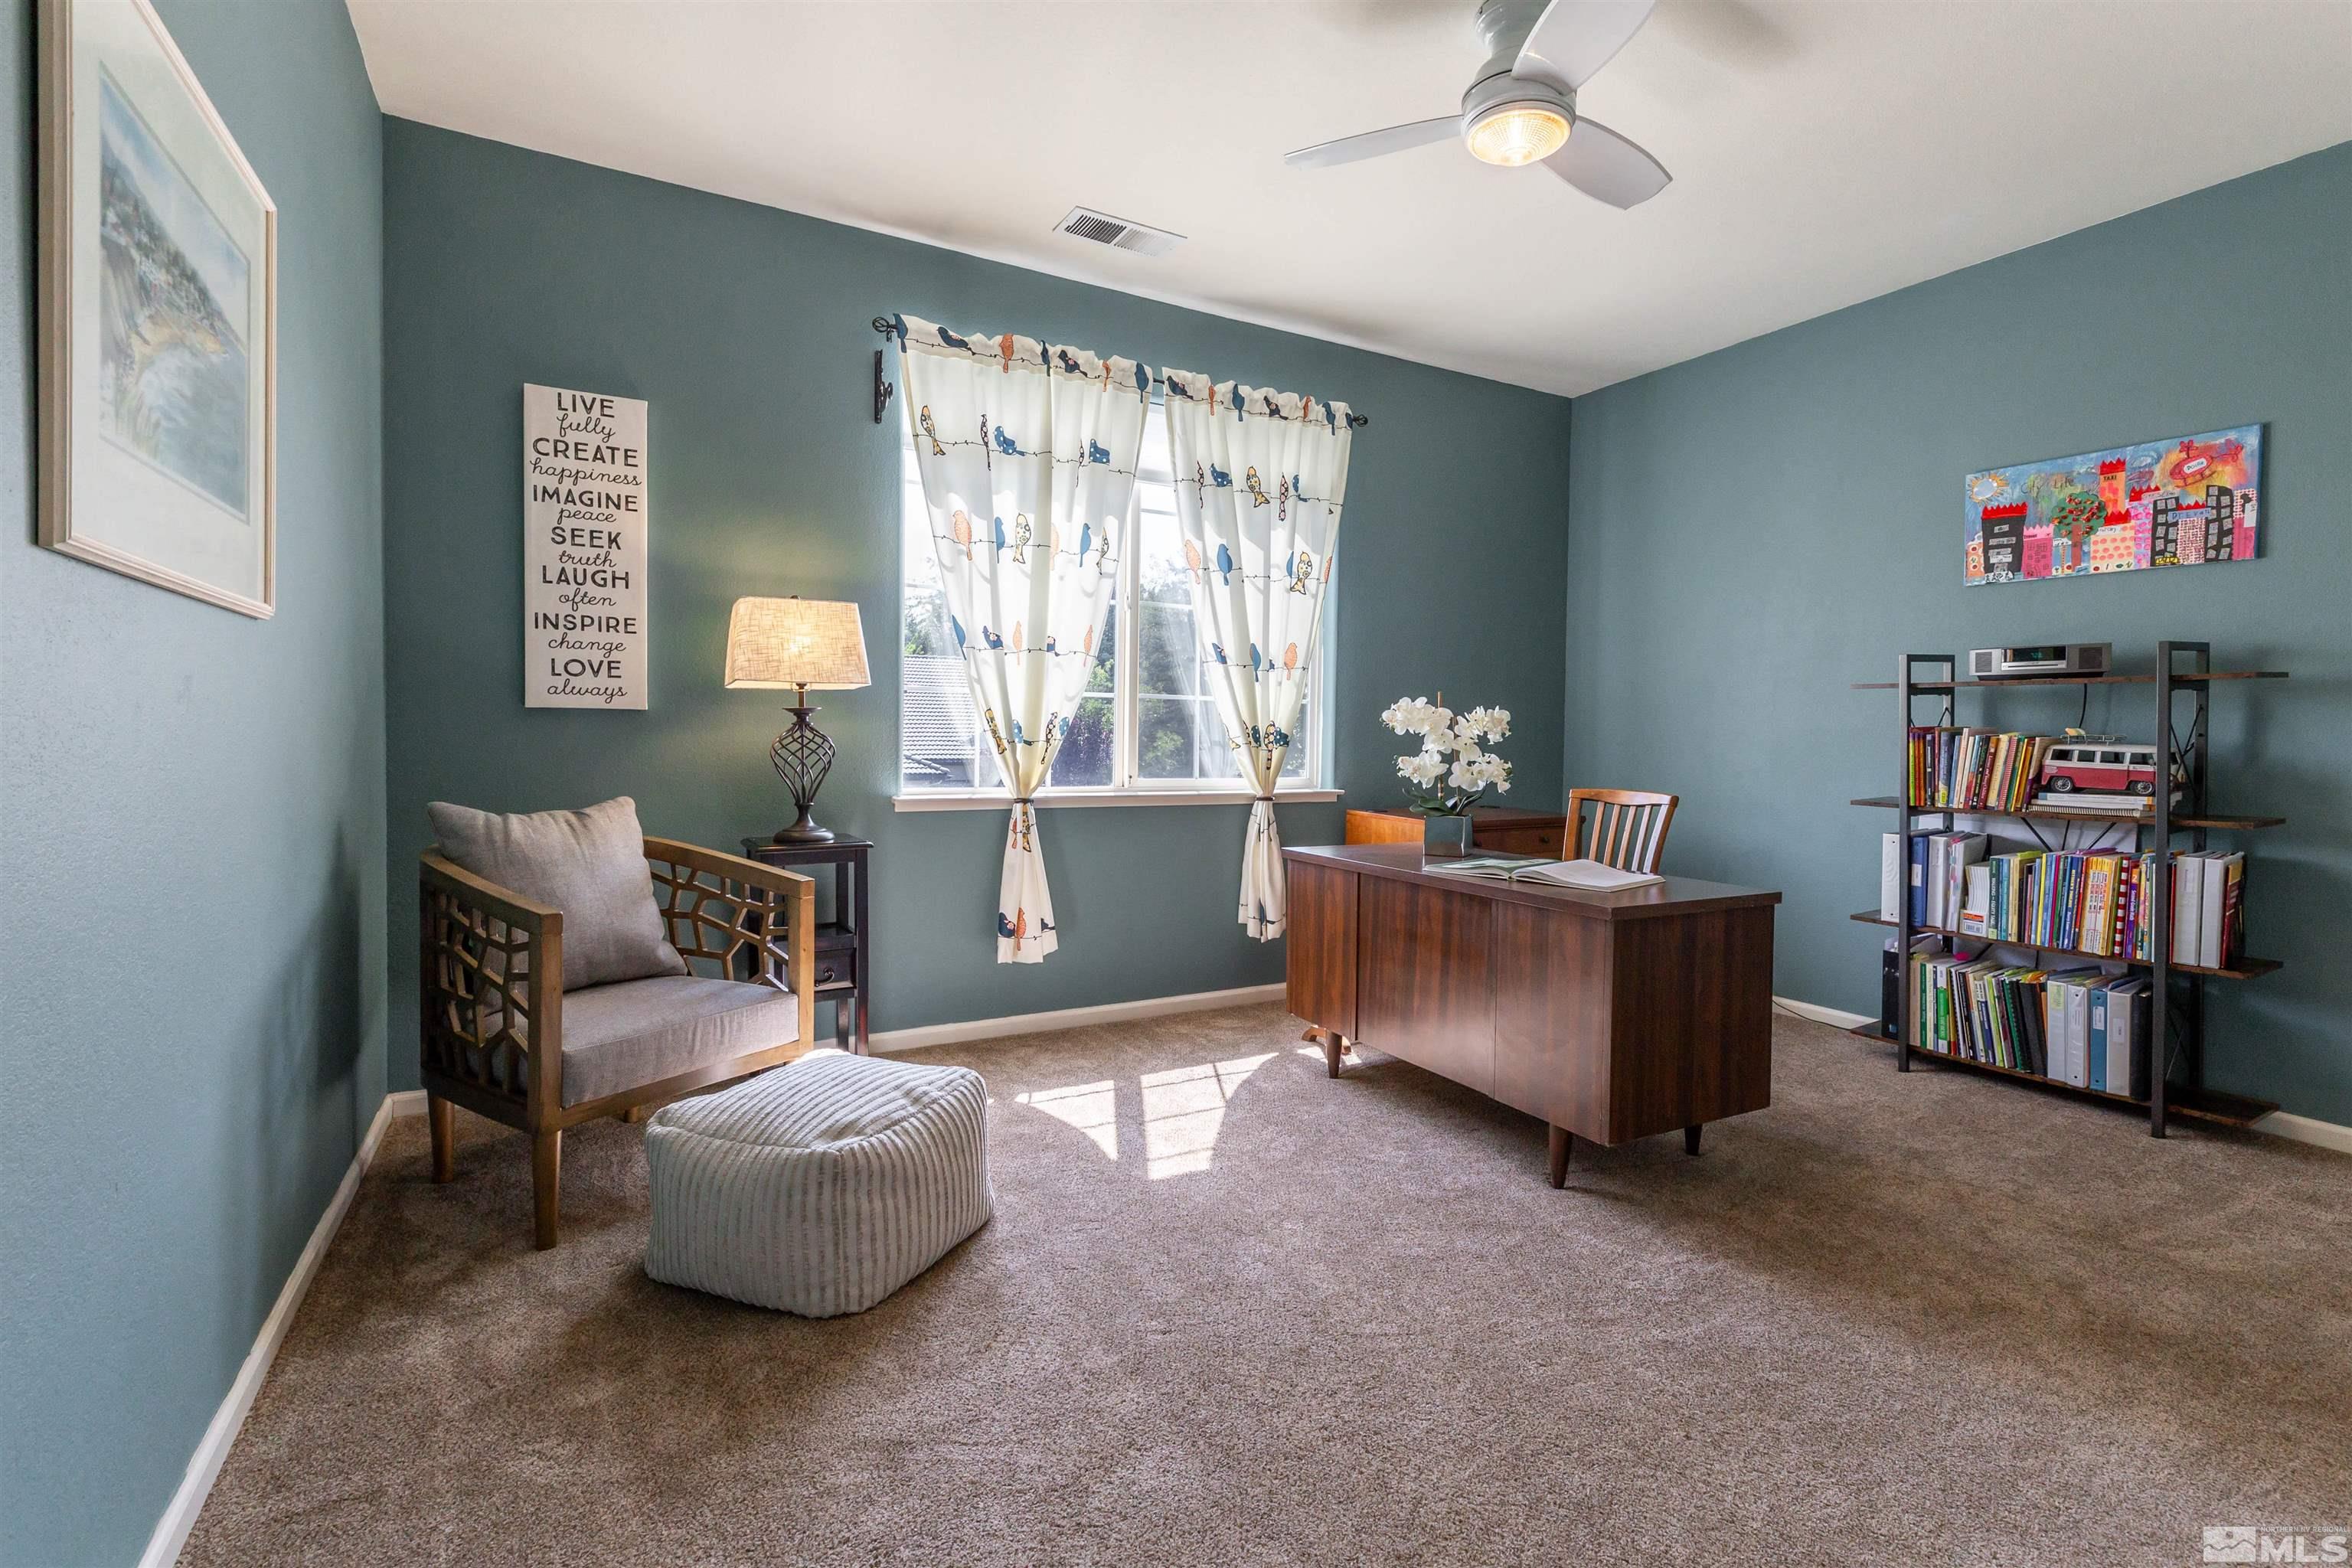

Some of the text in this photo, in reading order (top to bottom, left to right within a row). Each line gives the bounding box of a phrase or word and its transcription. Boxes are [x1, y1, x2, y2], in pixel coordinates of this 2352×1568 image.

[557, 392, 615, 418] LIVE
[557, 413, 616, 443] fully
[532, 437, 639, 467] CREATE
[530, 457, 642, 485] happiness
[533, 485, 638, 512] IMAGINE
[557, 508, 616, 524] peace
[550, 526, 622, 550] SEEK
[559, 550, 617, 567] truth
[542, 565, 629, 589] LAUGH
[558, 588, 616, 612] often
[534, 612, 637, 635] INSPIRE
[548, 632, 626, 658] change
[550, 658, 622, 678] LOVE
[547, 678, 628, 704] always
